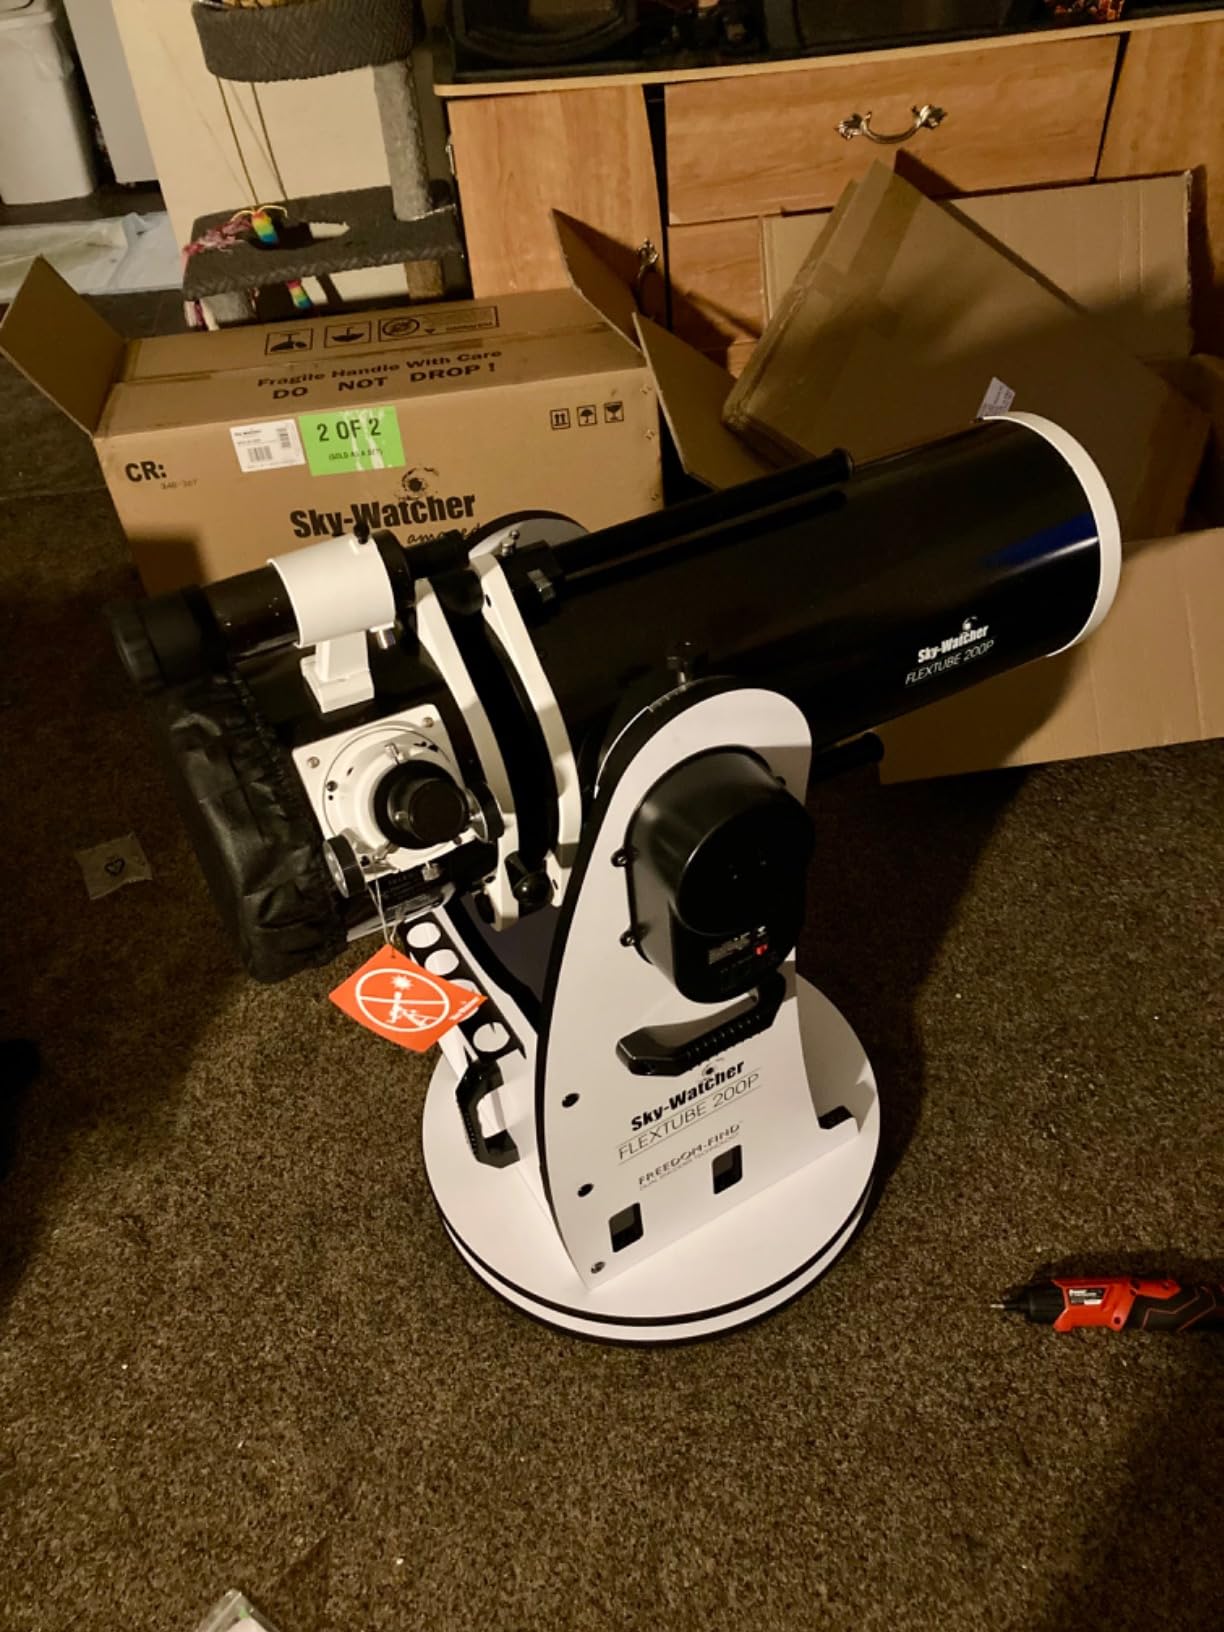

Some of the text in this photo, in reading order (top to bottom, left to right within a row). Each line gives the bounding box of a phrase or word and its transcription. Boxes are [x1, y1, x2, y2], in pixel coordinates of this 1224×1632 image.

[257, 349, 503, 387] Fragile Handle With Care
[272, 386, 308, 400] DO
[338, 376, 389, 392] NOT
[410, 364, 481, 383] DROP
[316, 417, 382, 442] 2 OF 2
[125, 460, 168, 482] CR:
[289, 494, 476, 538] Sky-Watcher
[905, 639, 995, 685] FLEXTUBE 200P
[917, 625, 989, 663] Sky-Watcher
[631, 1060, 745, 1131] Sky-Watcher
[617, 1072, 760, 1160] FLEXTUBE 200P
